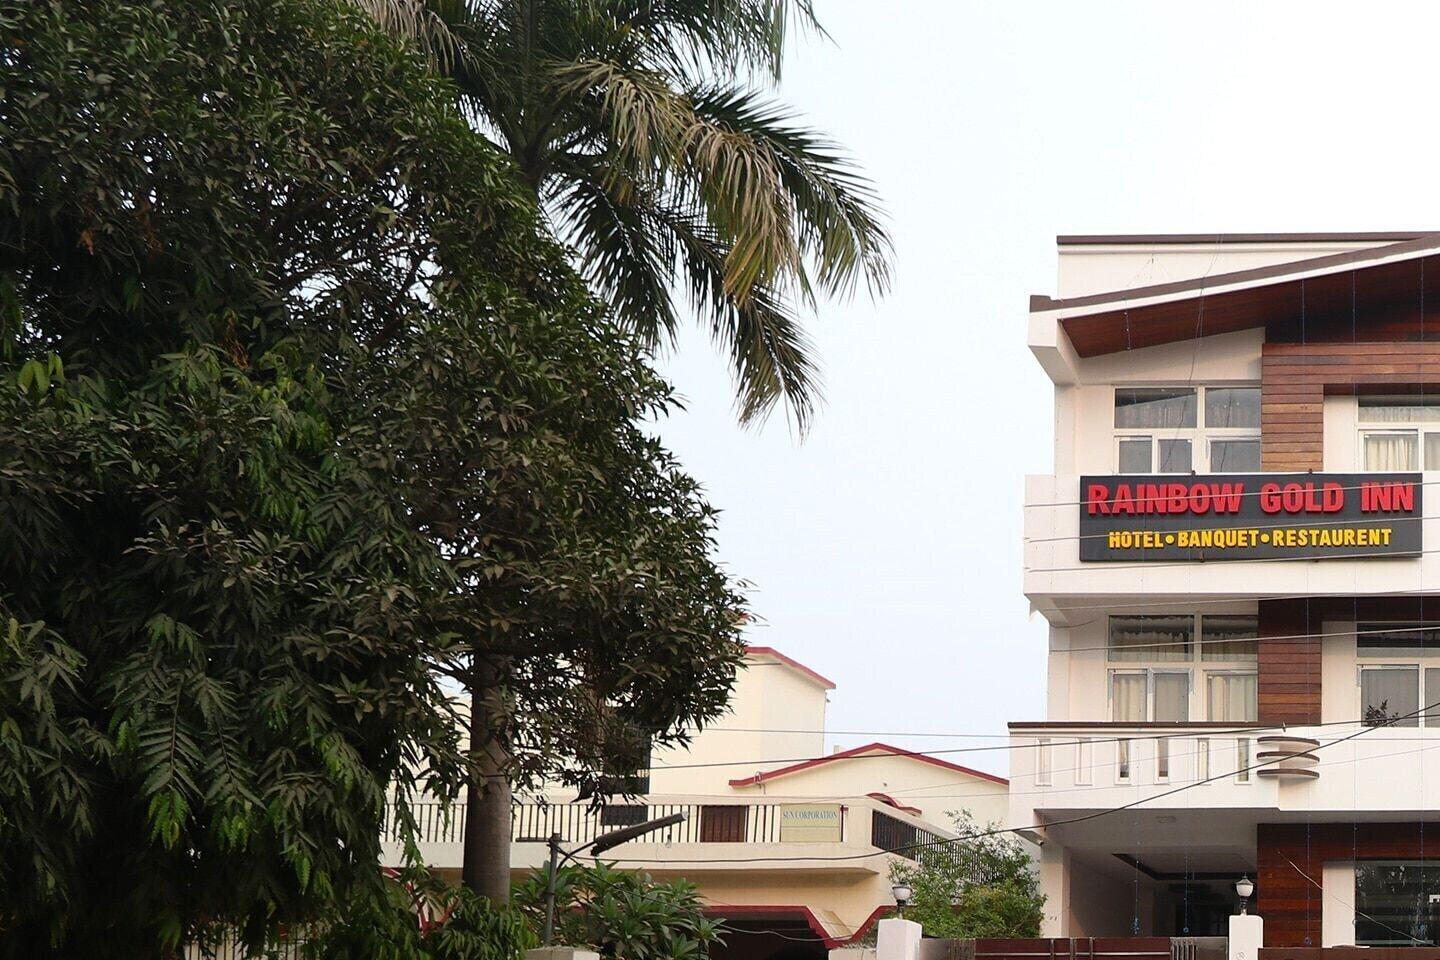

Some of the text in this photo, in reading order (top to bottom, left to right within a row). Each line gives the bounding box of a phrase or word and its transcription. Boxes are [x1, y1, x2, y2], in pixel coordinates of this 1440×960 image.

[1087, 481, 1414, 515] RAINBOW GOLD INN
[1109, 528, 1392, 549] HOTEL BANQUET RESTAURENT
[795, 810, 838, 819] CORPORATION
